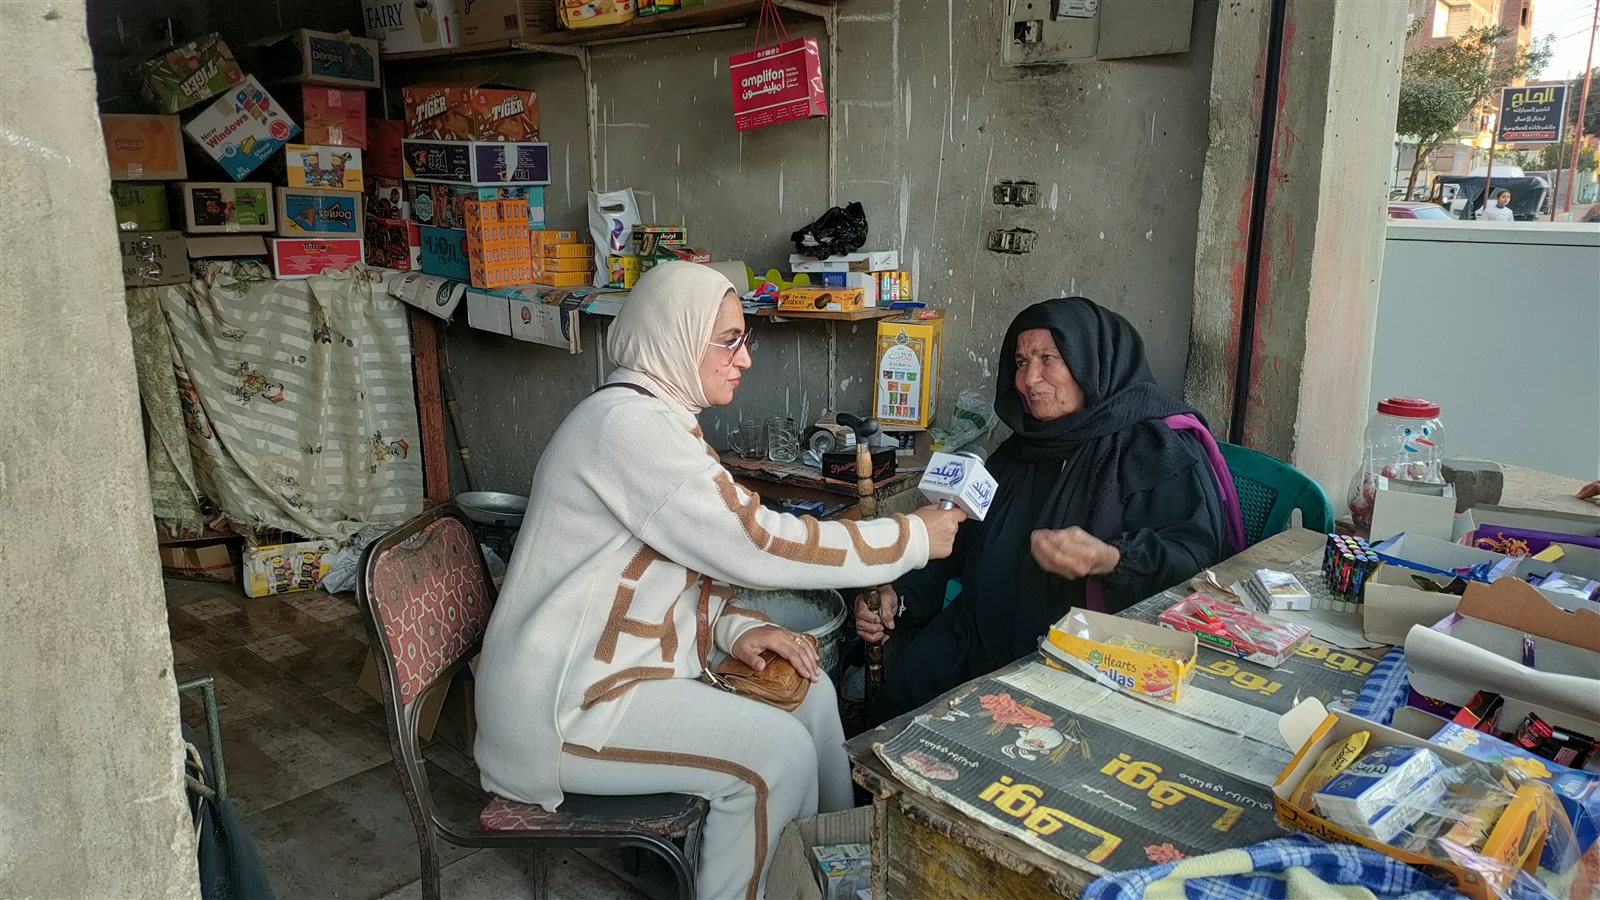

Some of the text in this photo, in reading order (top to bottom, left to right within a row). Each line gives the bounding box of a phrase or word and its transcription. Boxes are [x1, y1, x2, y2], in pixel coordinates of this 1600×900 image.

[366, 1, 404, 30] FAIRY
[312, 50, 344, 65] Doritos
[179, 59, 219, 97] TIGER
[741, 68, 785, 88] amplifon
[1512, 87, 1555, 108] الحاج
[415, 95, 448, 123] TIGER
[491, 98, 525, 122] TIGER
[200, 127, 217, 142] New
[206, 113, 250, 149] Windows
[318, 209, 352, 221] Doritos
[928, 465, 960, 480] البلد
[1104, 653, 1137, 673] Hearts
[1100, 752, 1245, 832] بوفا
[978, 775, 1123, 864] بوفا
